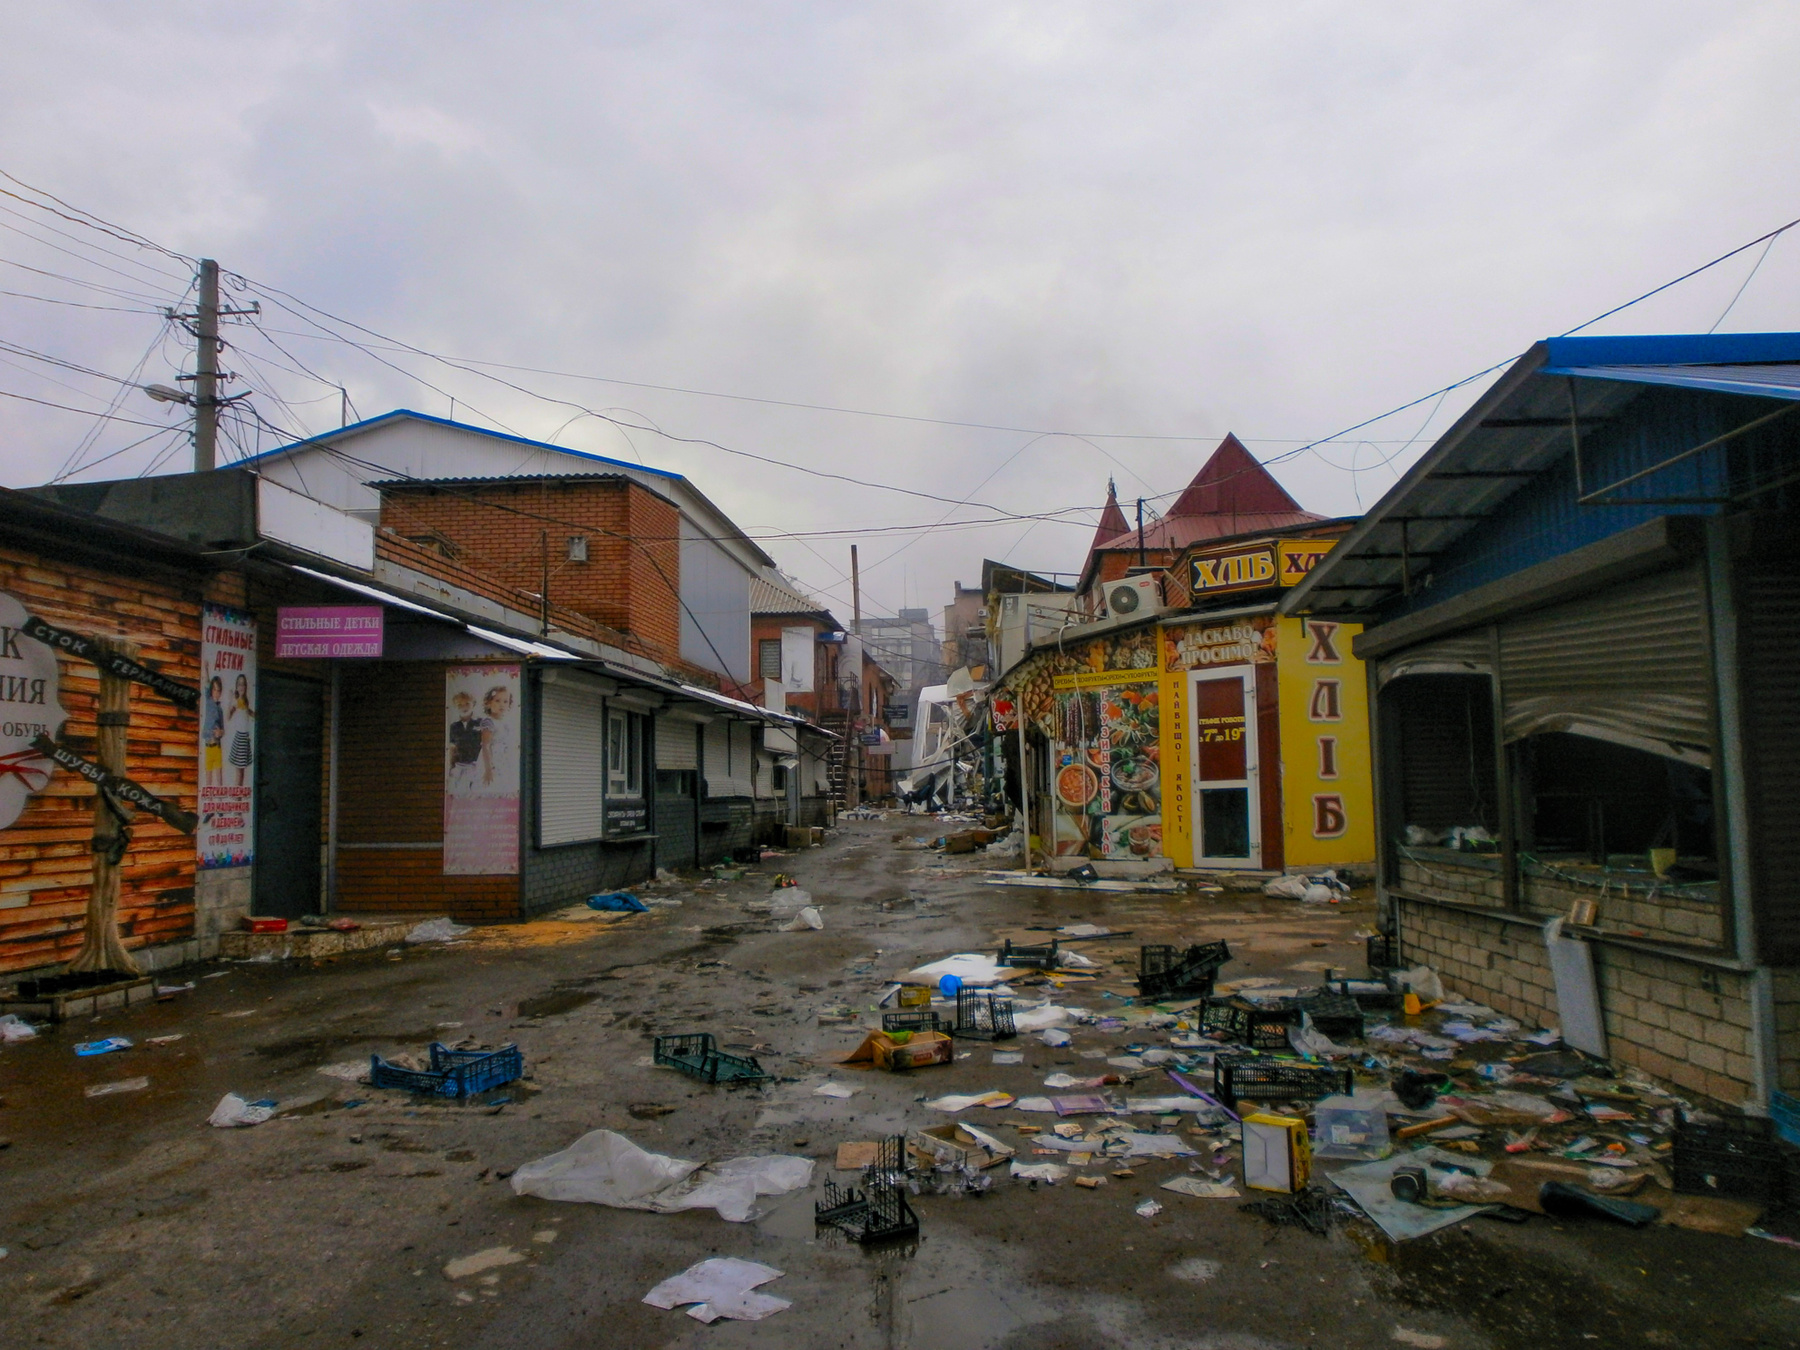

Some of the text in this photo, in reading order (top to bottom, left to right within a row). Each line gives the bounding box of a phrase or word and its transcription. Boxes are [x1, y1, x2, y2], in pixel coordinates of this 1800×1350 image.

[1194, 551, 1275, 589] ХЛІБ
[1285, 553, 1328, 573] ХЛ
[281, 617, 380, 630] СТИЛЬНЫЕ ДЕТКИ
[206, 625, 253, 650] СТИЛЬНЫЕ
[1184, 625, 1253, 647] ЛАСКАВО
[214, 650, 244, 671] ДЕТКИ
[280, 643, 378, 656] ДЕТСКАЯ ОДЕЖДА
[1181, 642, 1257, 665] ПРОСИМО!
[34, 626, 193, 700] СТОК ГЕРМАНИЯ
[0, 675, 46, 704] ИЯ
[3, 722, 49, 737] ОБУВЬ
[1307, 622, 1346, 837] ХЛІБ
[1173, 681, 1183, 833] НАЙВИЩОЇ ЯКОСТІ
[54, 748, 162, 814] ШУБЫ КОЖА
